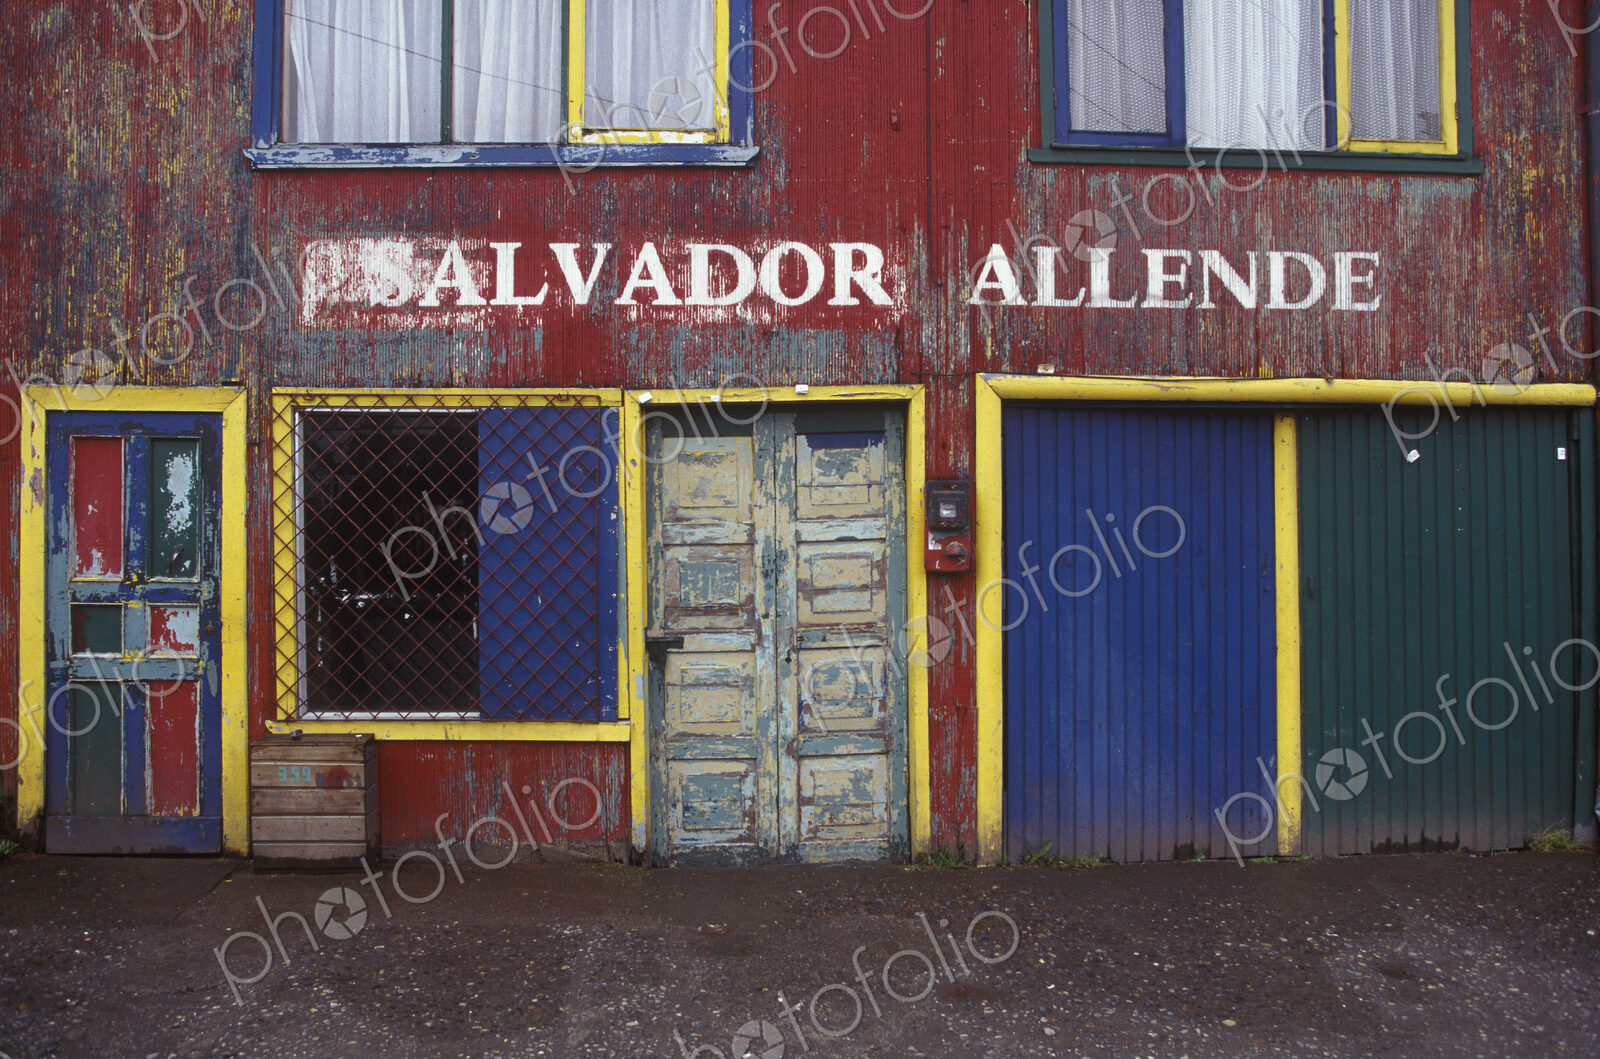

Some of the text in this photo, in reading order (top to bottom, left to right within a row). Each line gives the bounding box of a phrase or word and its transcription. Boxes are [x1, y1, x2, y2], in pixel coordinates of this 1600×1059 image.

[366, 241, 1382, 311] SALVADOR ALLENDE
[278, 766, 311, 783] 359
